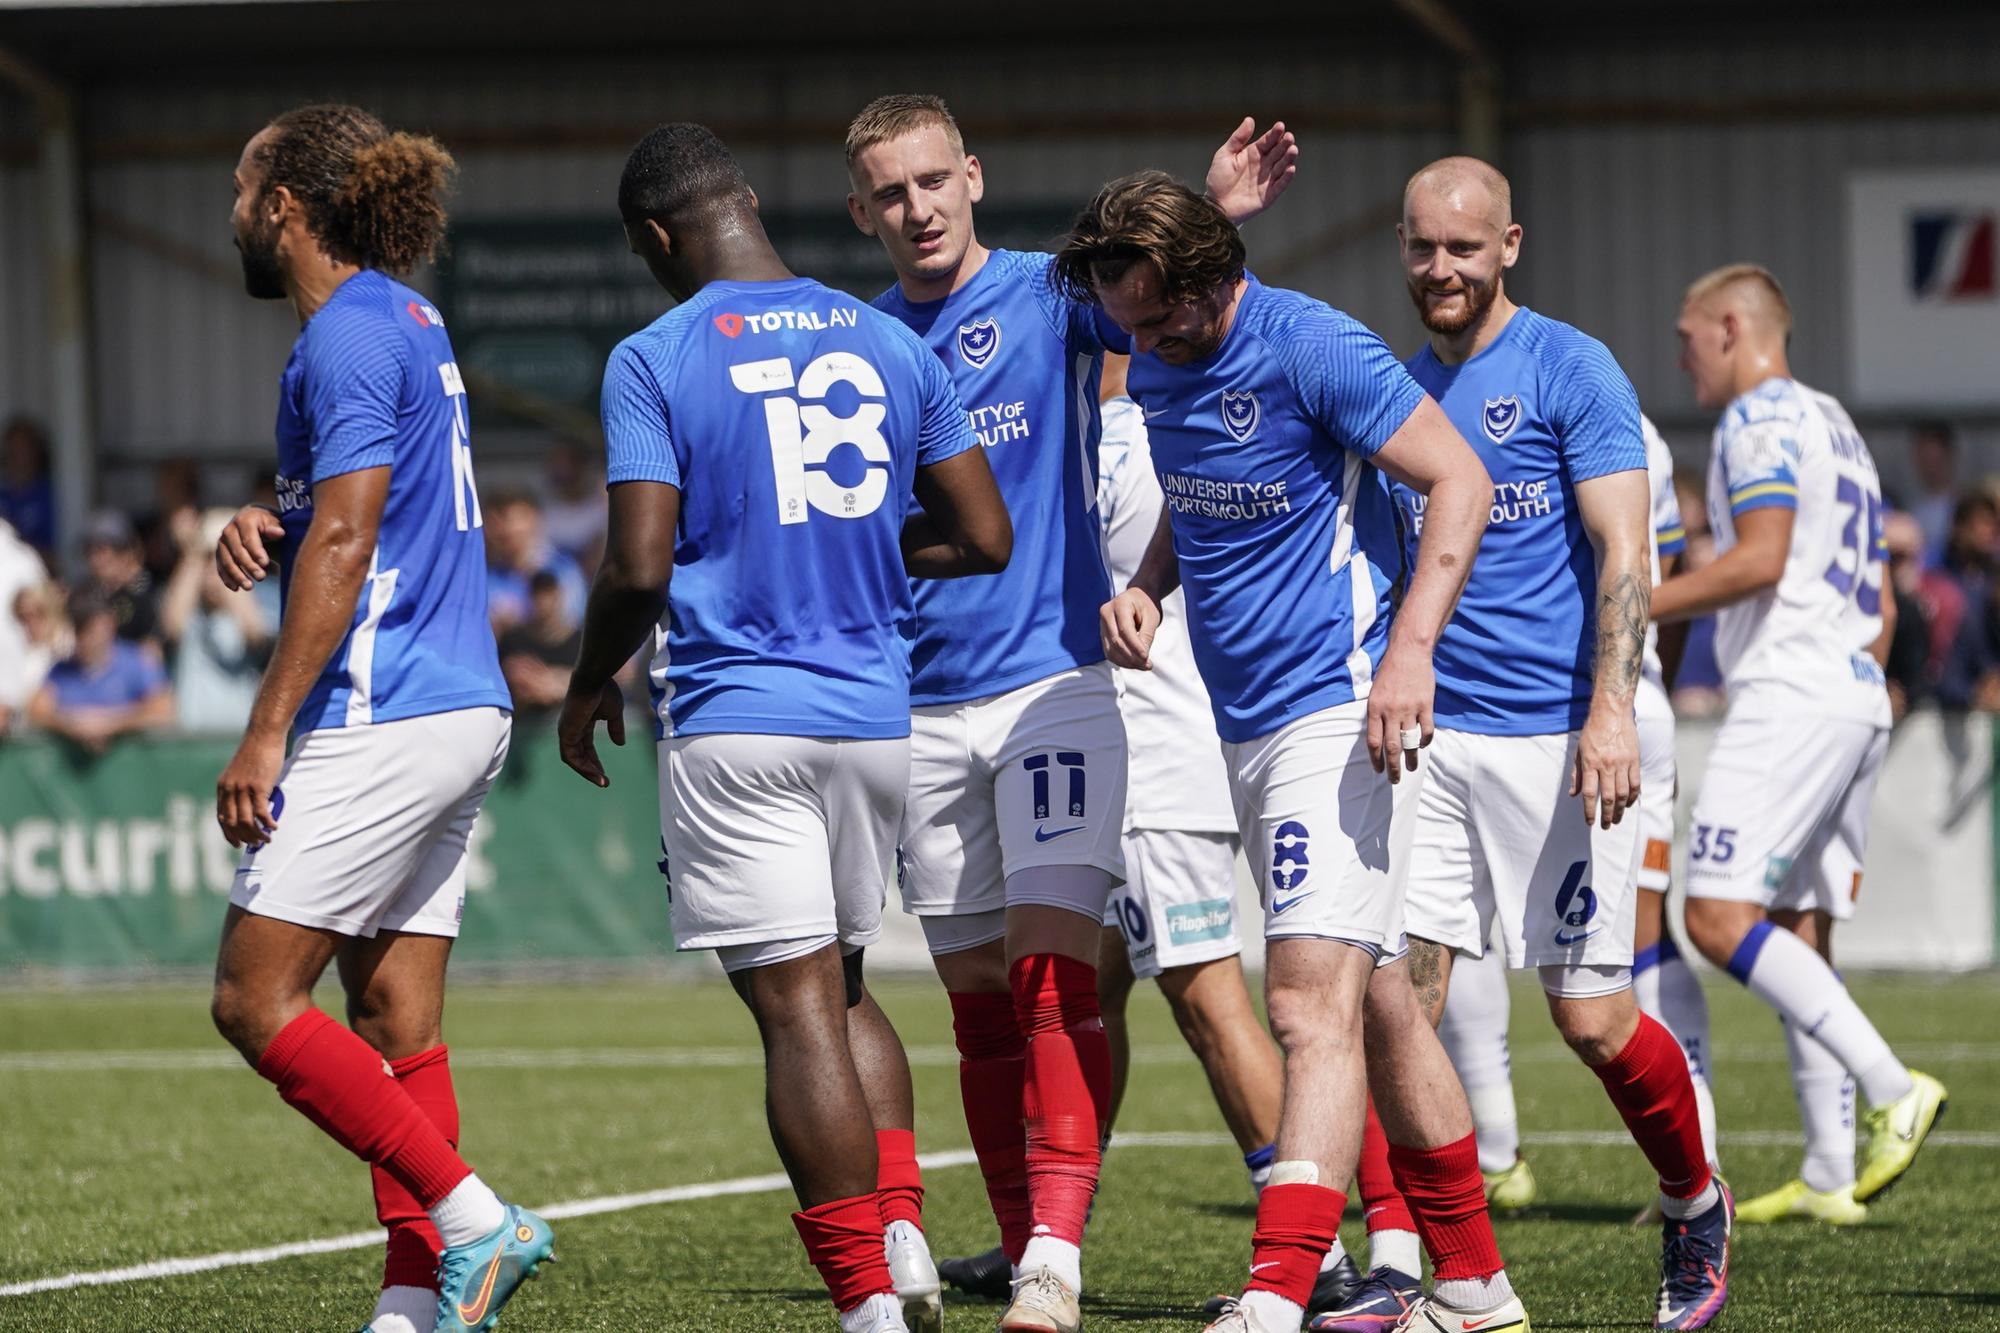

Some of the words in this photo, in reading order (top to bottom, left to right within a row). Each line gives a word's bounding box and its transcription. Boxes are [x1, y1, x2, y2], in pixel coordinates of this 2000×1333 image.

[729, 352, 891, 526] 18
[968, 402, 1003, 430] ITY
[1004, 401, 1025, 419] OF
[1161, 472, 1262, 501] UNIVERSITY
[1263, 480, 1287, 498] OF
[1166, 493, 1292, 520] PORTSMOUTH
[1526, 480, 1548, 498] OF
[1023, 752, 1086, 820] 11
[0, 793, 235, 899] curit
[1272, 821, 1310, 892] 8
[1692, 825, 1738, 862] 35
[1555, 861, 1598, 928] 6
